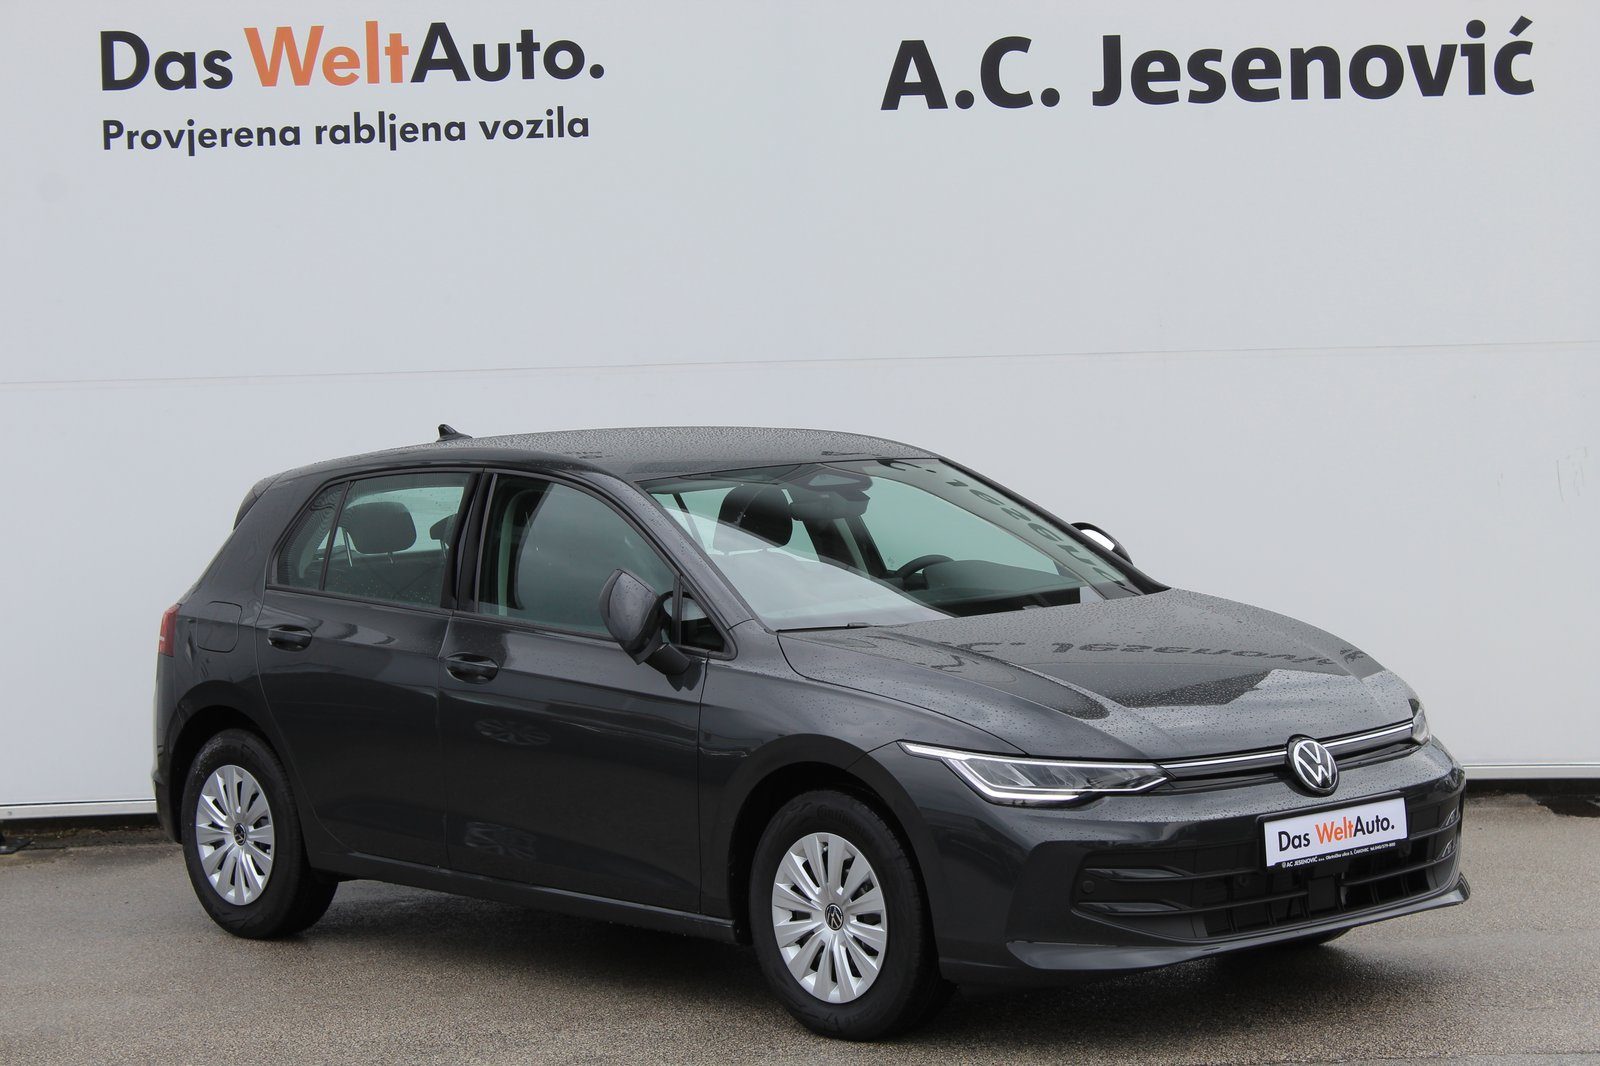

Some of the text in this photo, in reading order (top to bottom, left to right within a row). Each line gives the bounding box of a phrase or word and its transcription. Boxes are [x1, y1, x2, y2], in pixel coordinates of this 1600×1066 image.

[100, 21, 604, 91] Das WeltAuto.
[881, 16, 1534, 110] A.C. Jesenović
[103, 106, 588, 156] Provjerena rabljena vozila
[1278, 815, 1395, 852] Das WeltAuto.
